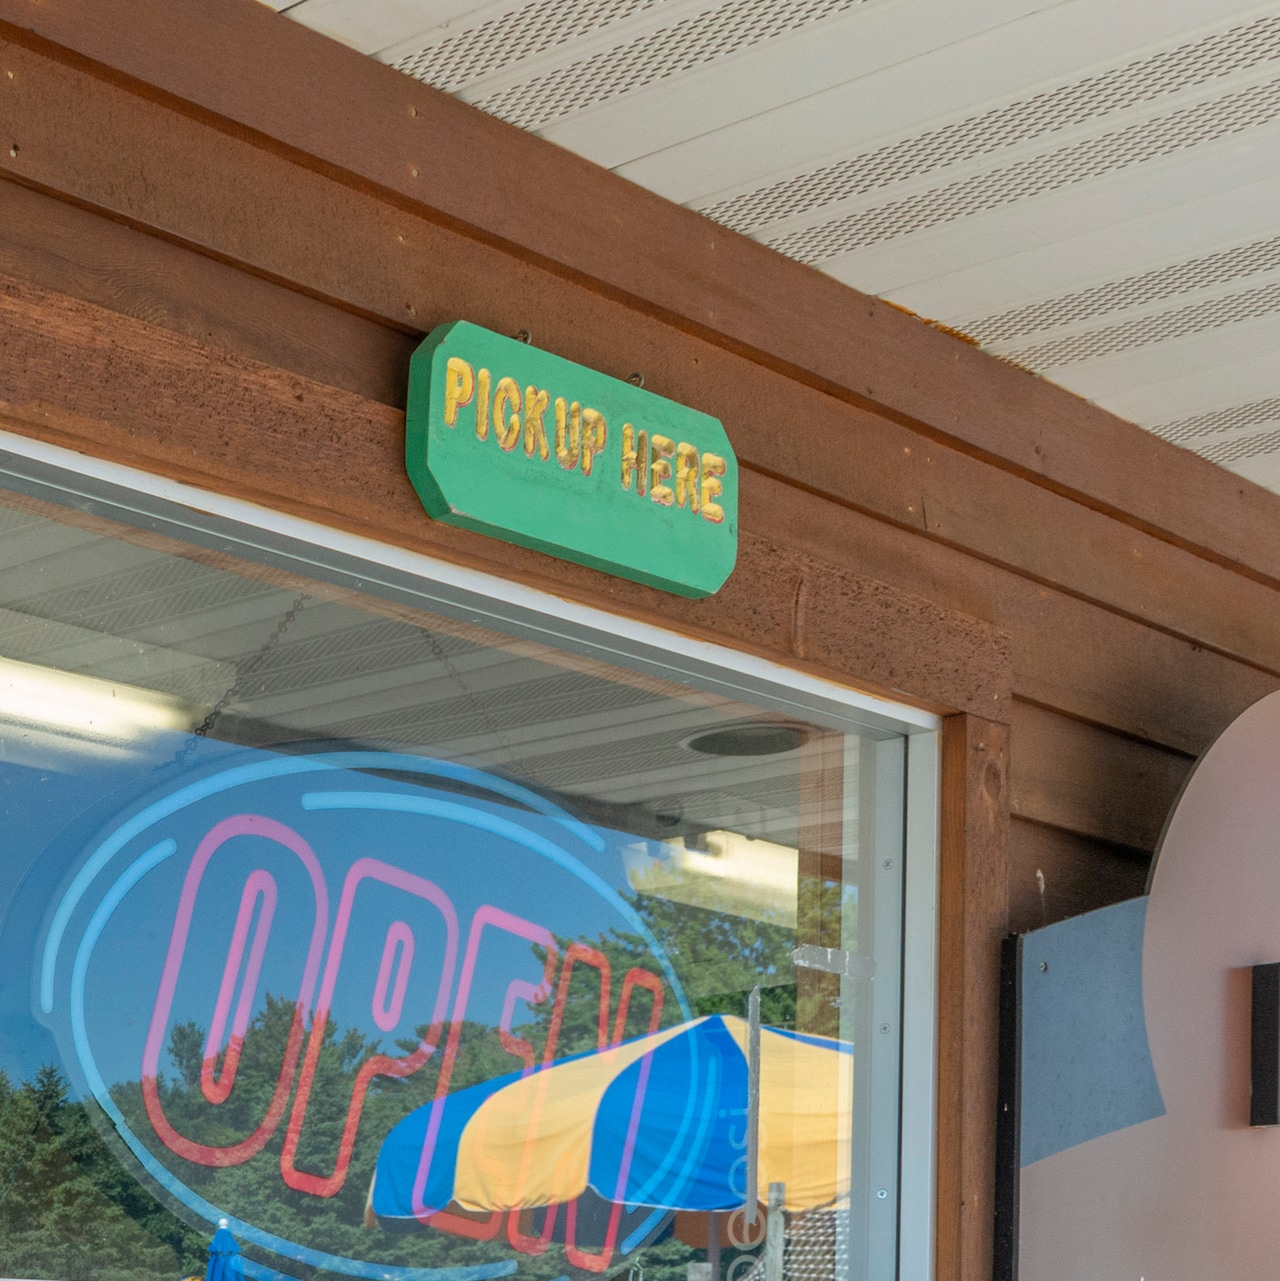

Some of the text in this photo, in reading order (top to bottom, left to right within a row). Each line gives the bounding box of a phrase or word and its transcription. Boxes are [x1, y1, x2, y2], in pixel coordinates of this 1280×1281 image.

[443, 356, 727, 524] PICKUP HERE
[141, 815, 666, 1274] OPEN
